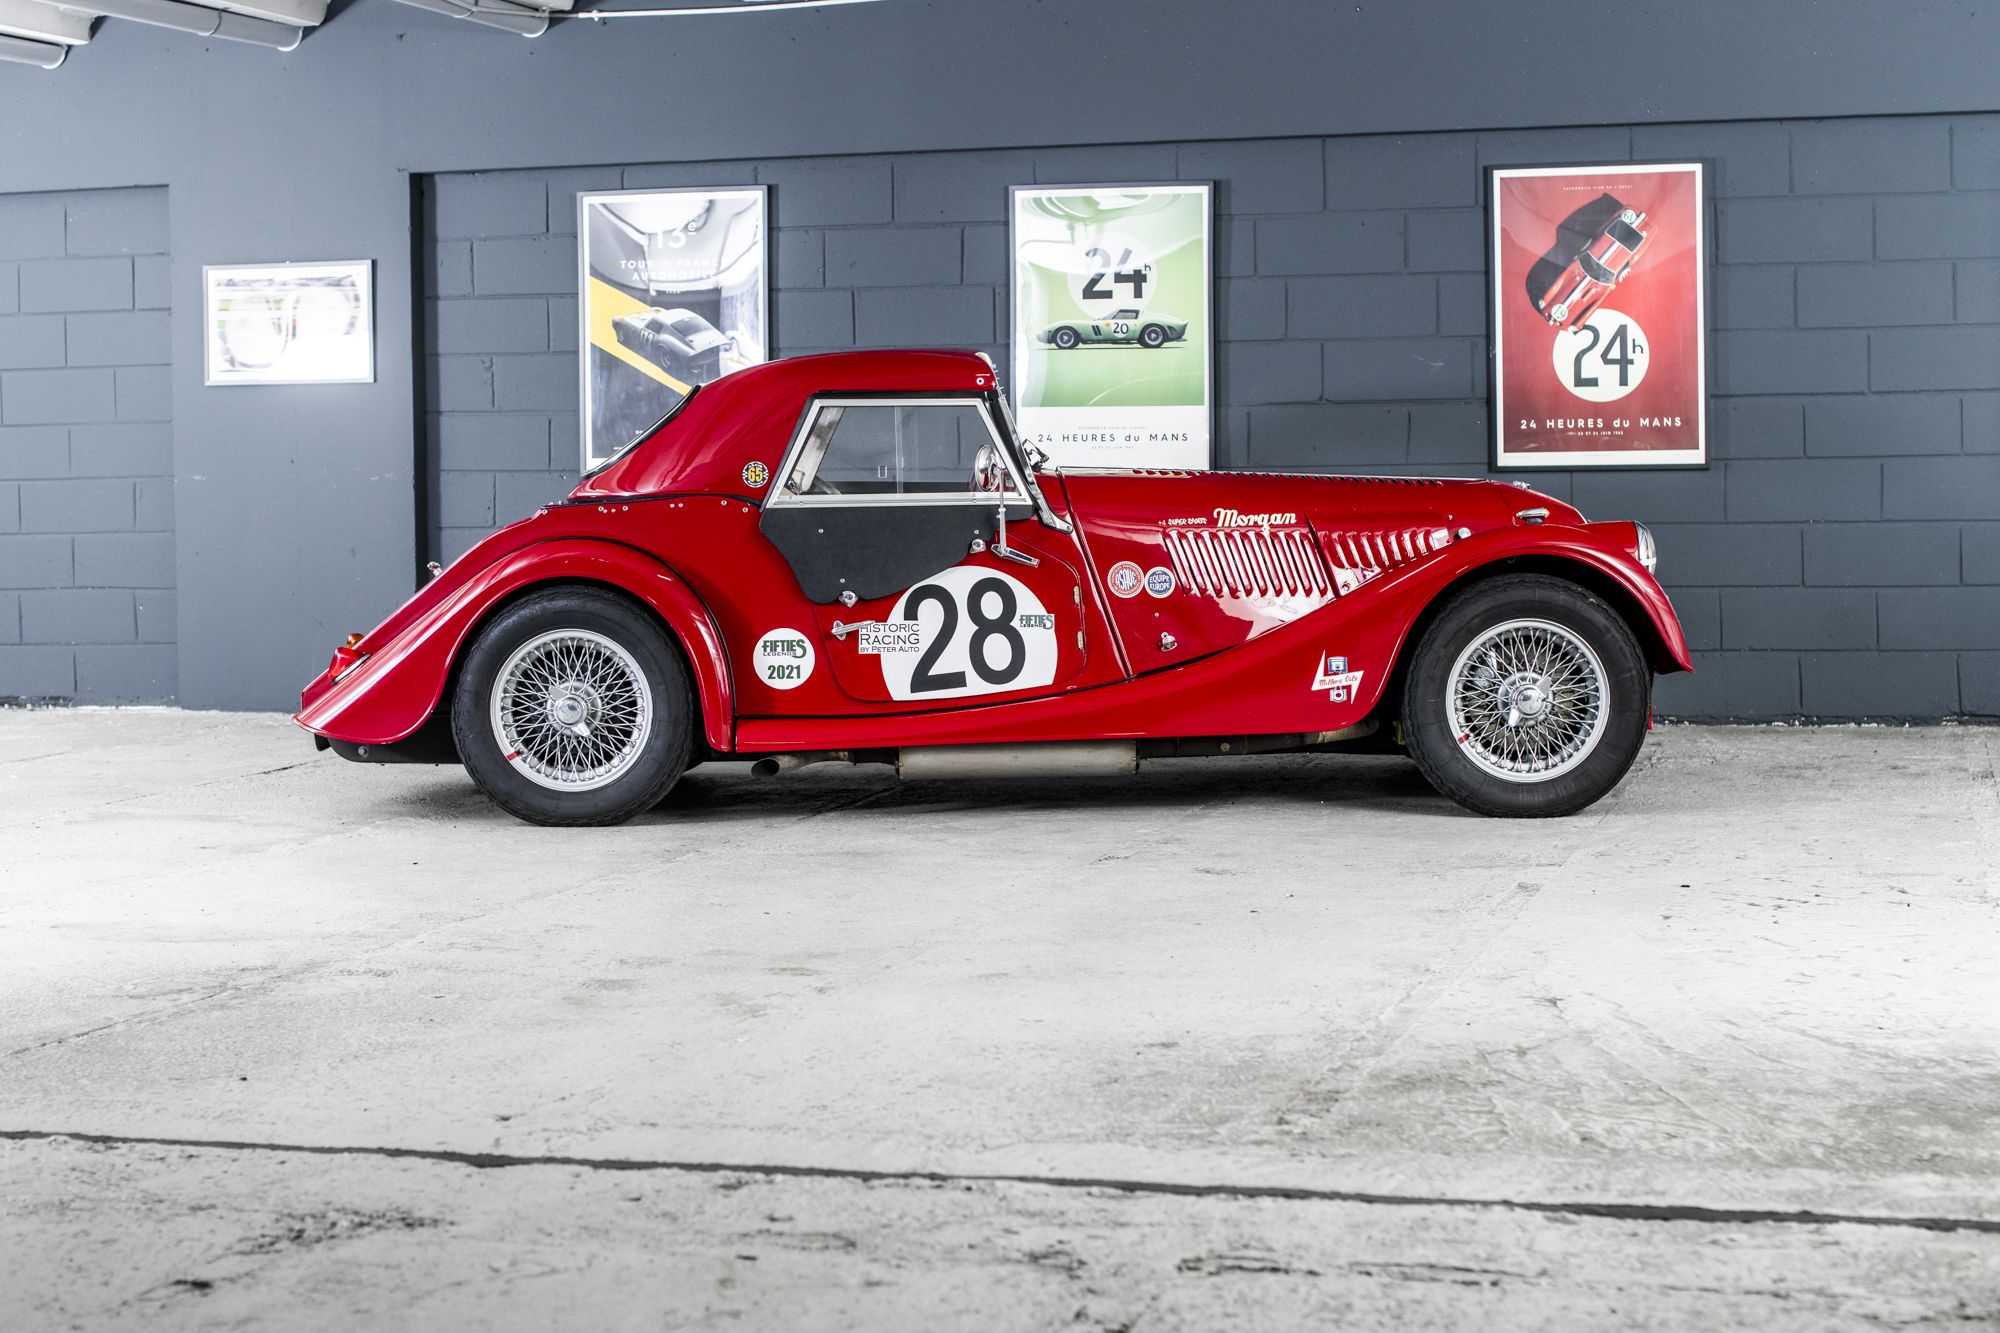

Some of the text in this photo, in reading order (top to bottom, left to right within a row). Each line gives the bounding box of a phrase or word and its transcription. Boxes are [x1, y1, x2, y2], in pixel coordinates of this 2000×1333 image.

[1113, 322, 1129, 334] 20
[1520, 416, 1682, 429] 24 HEURES du MANS
[1038, 432, 1189, 442] 24 HEURES du MANS
[747, 466, 764, 483] 65
[1213, 507, 1297, 533] Morgan
[860, 633, 920, 645] RACING
[904, 577, 1026, 693] 28
[761, 638, 807, 659] FIFTIES
[767, 664, 801, 680] 2021
